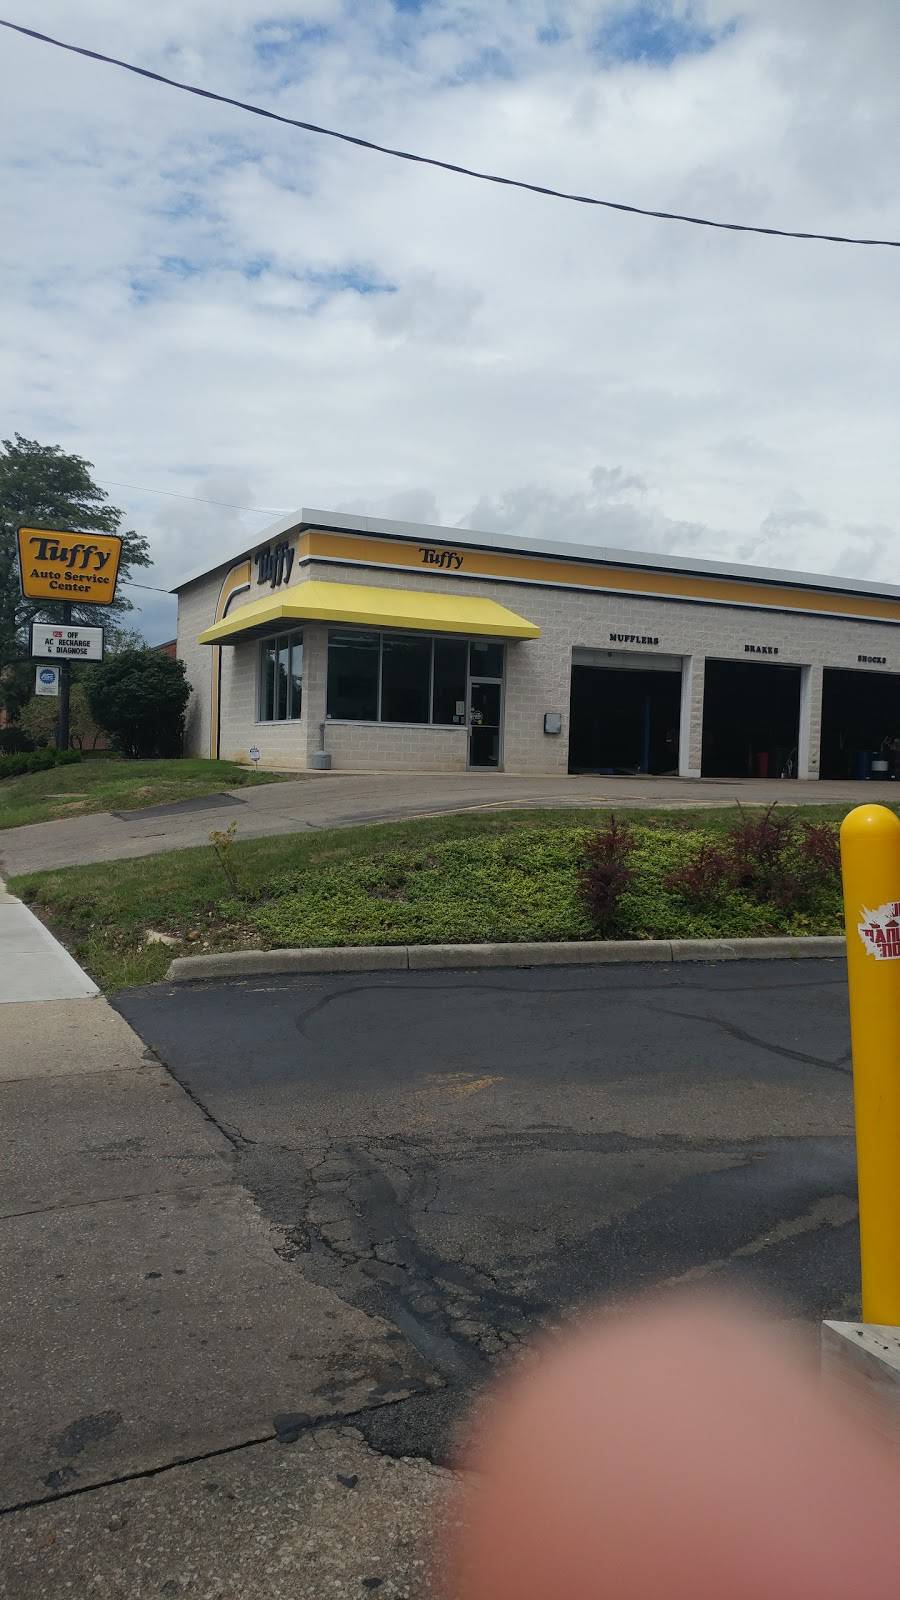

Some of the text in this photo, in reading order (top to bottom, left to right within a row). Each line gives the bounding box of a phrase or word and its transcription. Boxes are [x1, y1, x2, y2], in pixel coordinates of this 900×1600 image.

[29, 537, 111, 571] Tuffy
[418, 548, 464, 569] Tuffy
[254, 540, 295, 588] Tuffy
[30, 569, 110, 584] Auto Service
[49, 581, 91, 592] Center
[609, 633, 659, 645] MUFFLERS
[56, 647, 88, 655] DIAGNOSE
[744, 644, 779, 655] BRAKES
[857, 655, 887, 664] SHOCKS
